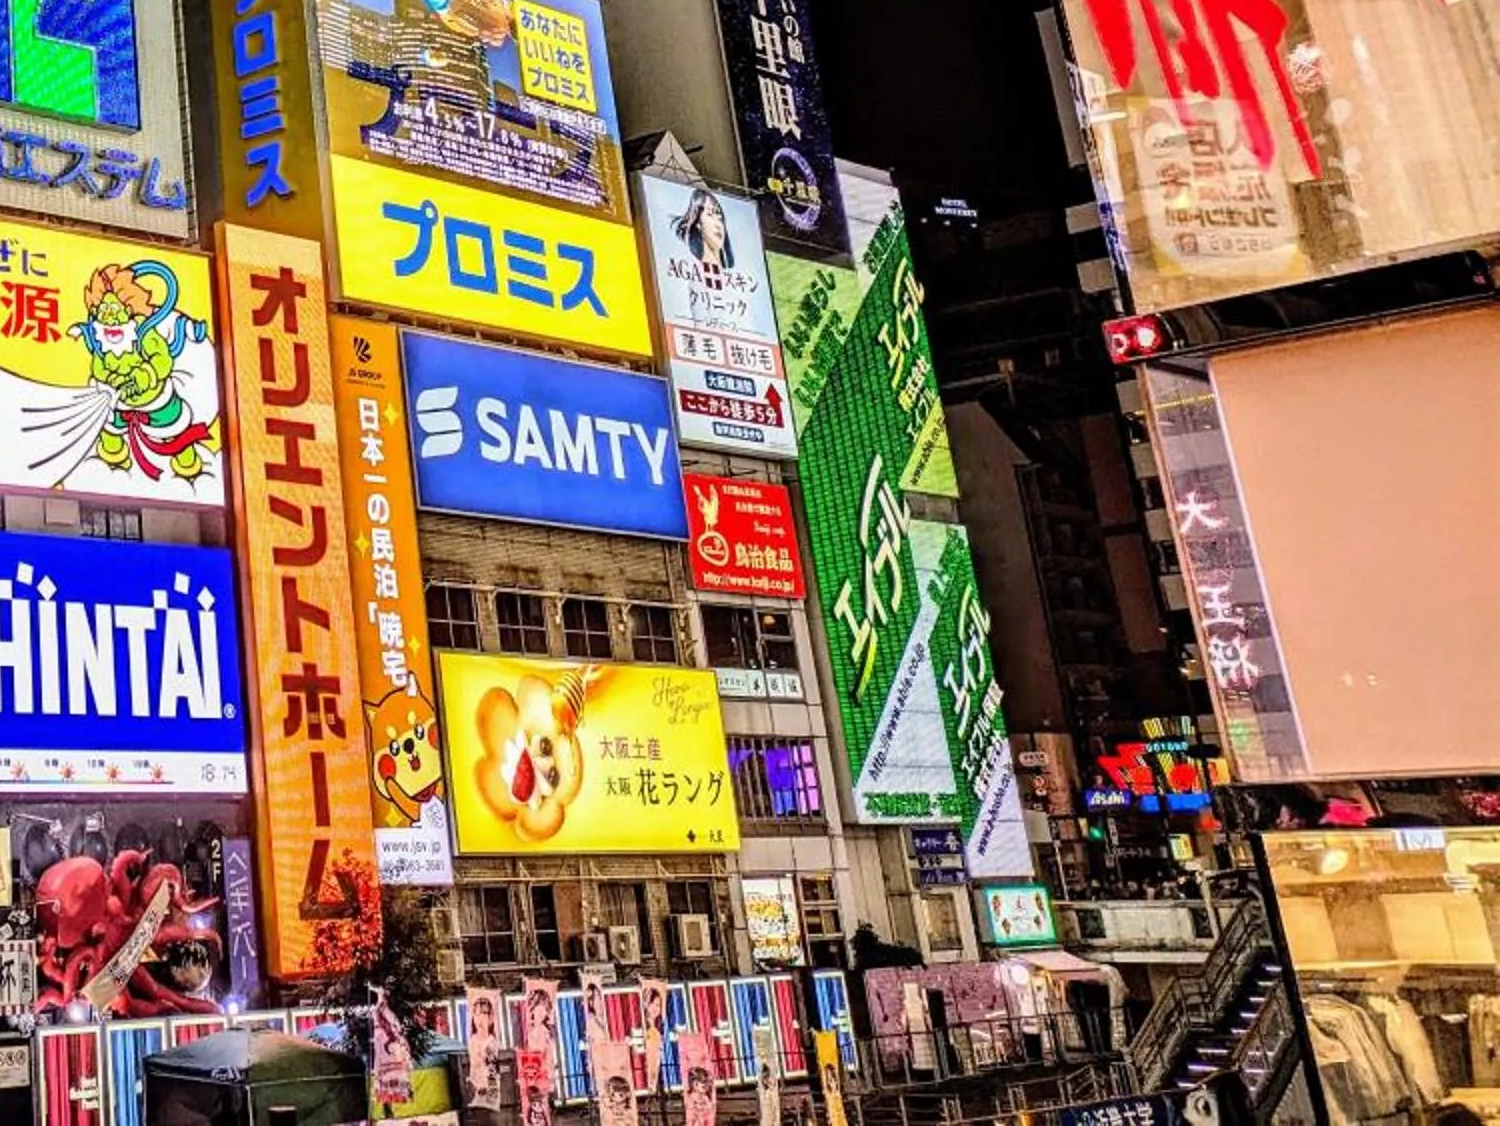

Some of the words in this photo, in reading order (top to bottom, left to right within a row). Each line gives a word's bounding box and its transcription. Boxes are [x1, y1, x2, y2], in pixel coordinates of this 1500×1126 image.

[518, 6, 584, 48] あなたに
[523, 36, 587, 77] いいねを
[526, 64, 593, 104] プロミス
[381, 198, 611, 319] プロミス
[689, 289, 748, 317] クリニック
[724, 271, 760, 294] スキン
[476, 398, 669, 487] SAMTY
[250, 265, 361, 921] オリエントホーム
[599, 735, 664, 762] 大阪土産
[605, 776, 633, 798] 大阪
[636, 767, 725, 808] 花ラング
